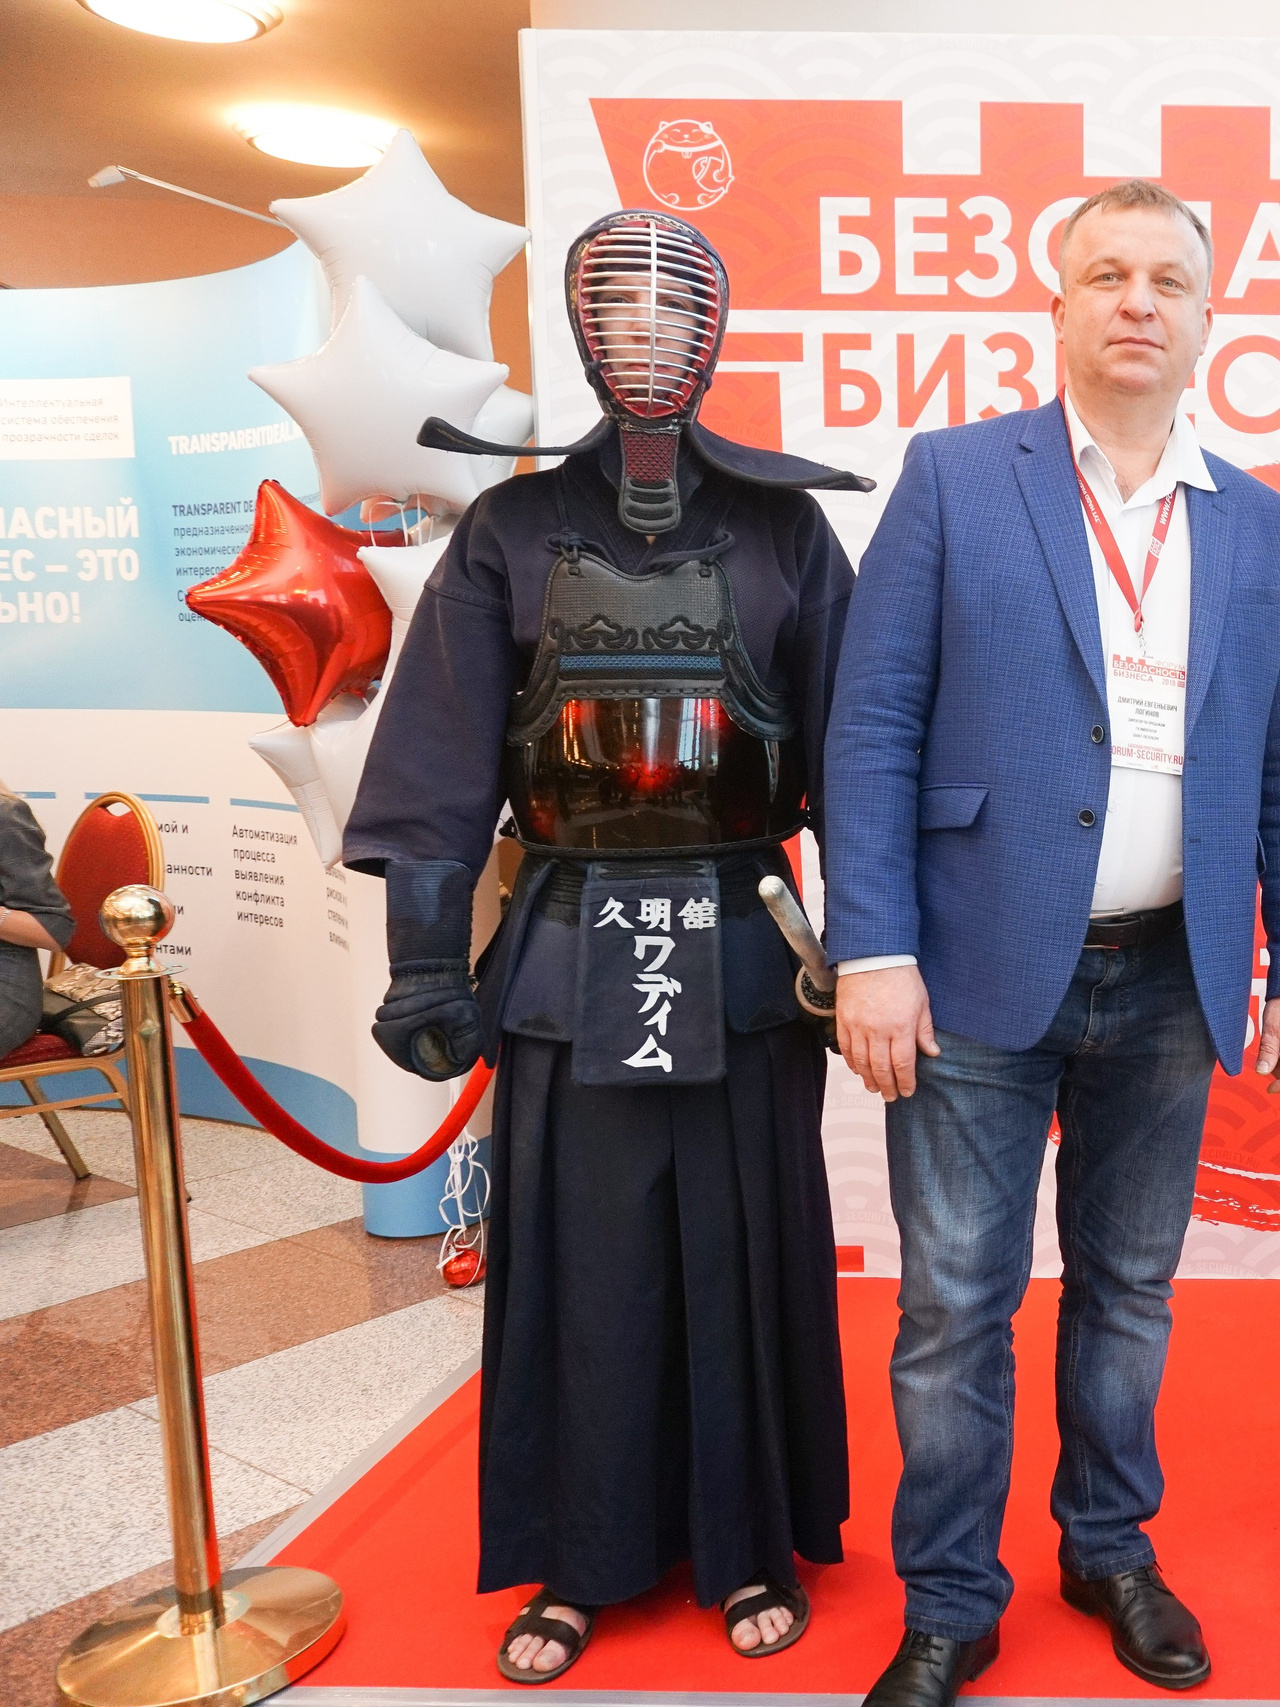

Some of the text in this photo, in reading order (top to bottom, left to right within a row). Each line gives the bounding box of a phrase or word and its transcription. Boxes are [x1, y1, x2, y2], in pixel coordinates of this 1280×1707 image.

[1, 413, 119, 425] система обеспечения
[2, 431, 119, 443] прозрачности сделок
[172, 500, 257, 517] TRANSPARENT DE
[1159, 488, 1175, 525] WWW.FO
[0, 496, 140, 539] АСНЫЙ
[76, 548, 139, 581] ЭТО
[1113, 660, 1185, 680] БЕЗОПАСНОСТЬ
[1156, 660, 1186, 671] ФОРУМ
[1113, 669, 1176, 687] БИЗНЕСА 2019
[1117, 696, 1178, 712] ДМИТРИЙ ЕВГЕНЬЕВИЧ
[1135, 708, 1160, 718] ЛОГИНОВ
[1111, 745, 1184, 766] ORUM-SECURITY.RU
[182, 826, 189, 834] и
[231, 824, 299, 847] Автоматизация
[233, 848, 276, 864] процесса
[234, 869, 285, 886] выявления
[235, 889, 285, 908] конфликта
[236, 911, 284, 929] интересов
[621, 934, 682, 1073] ワディム
